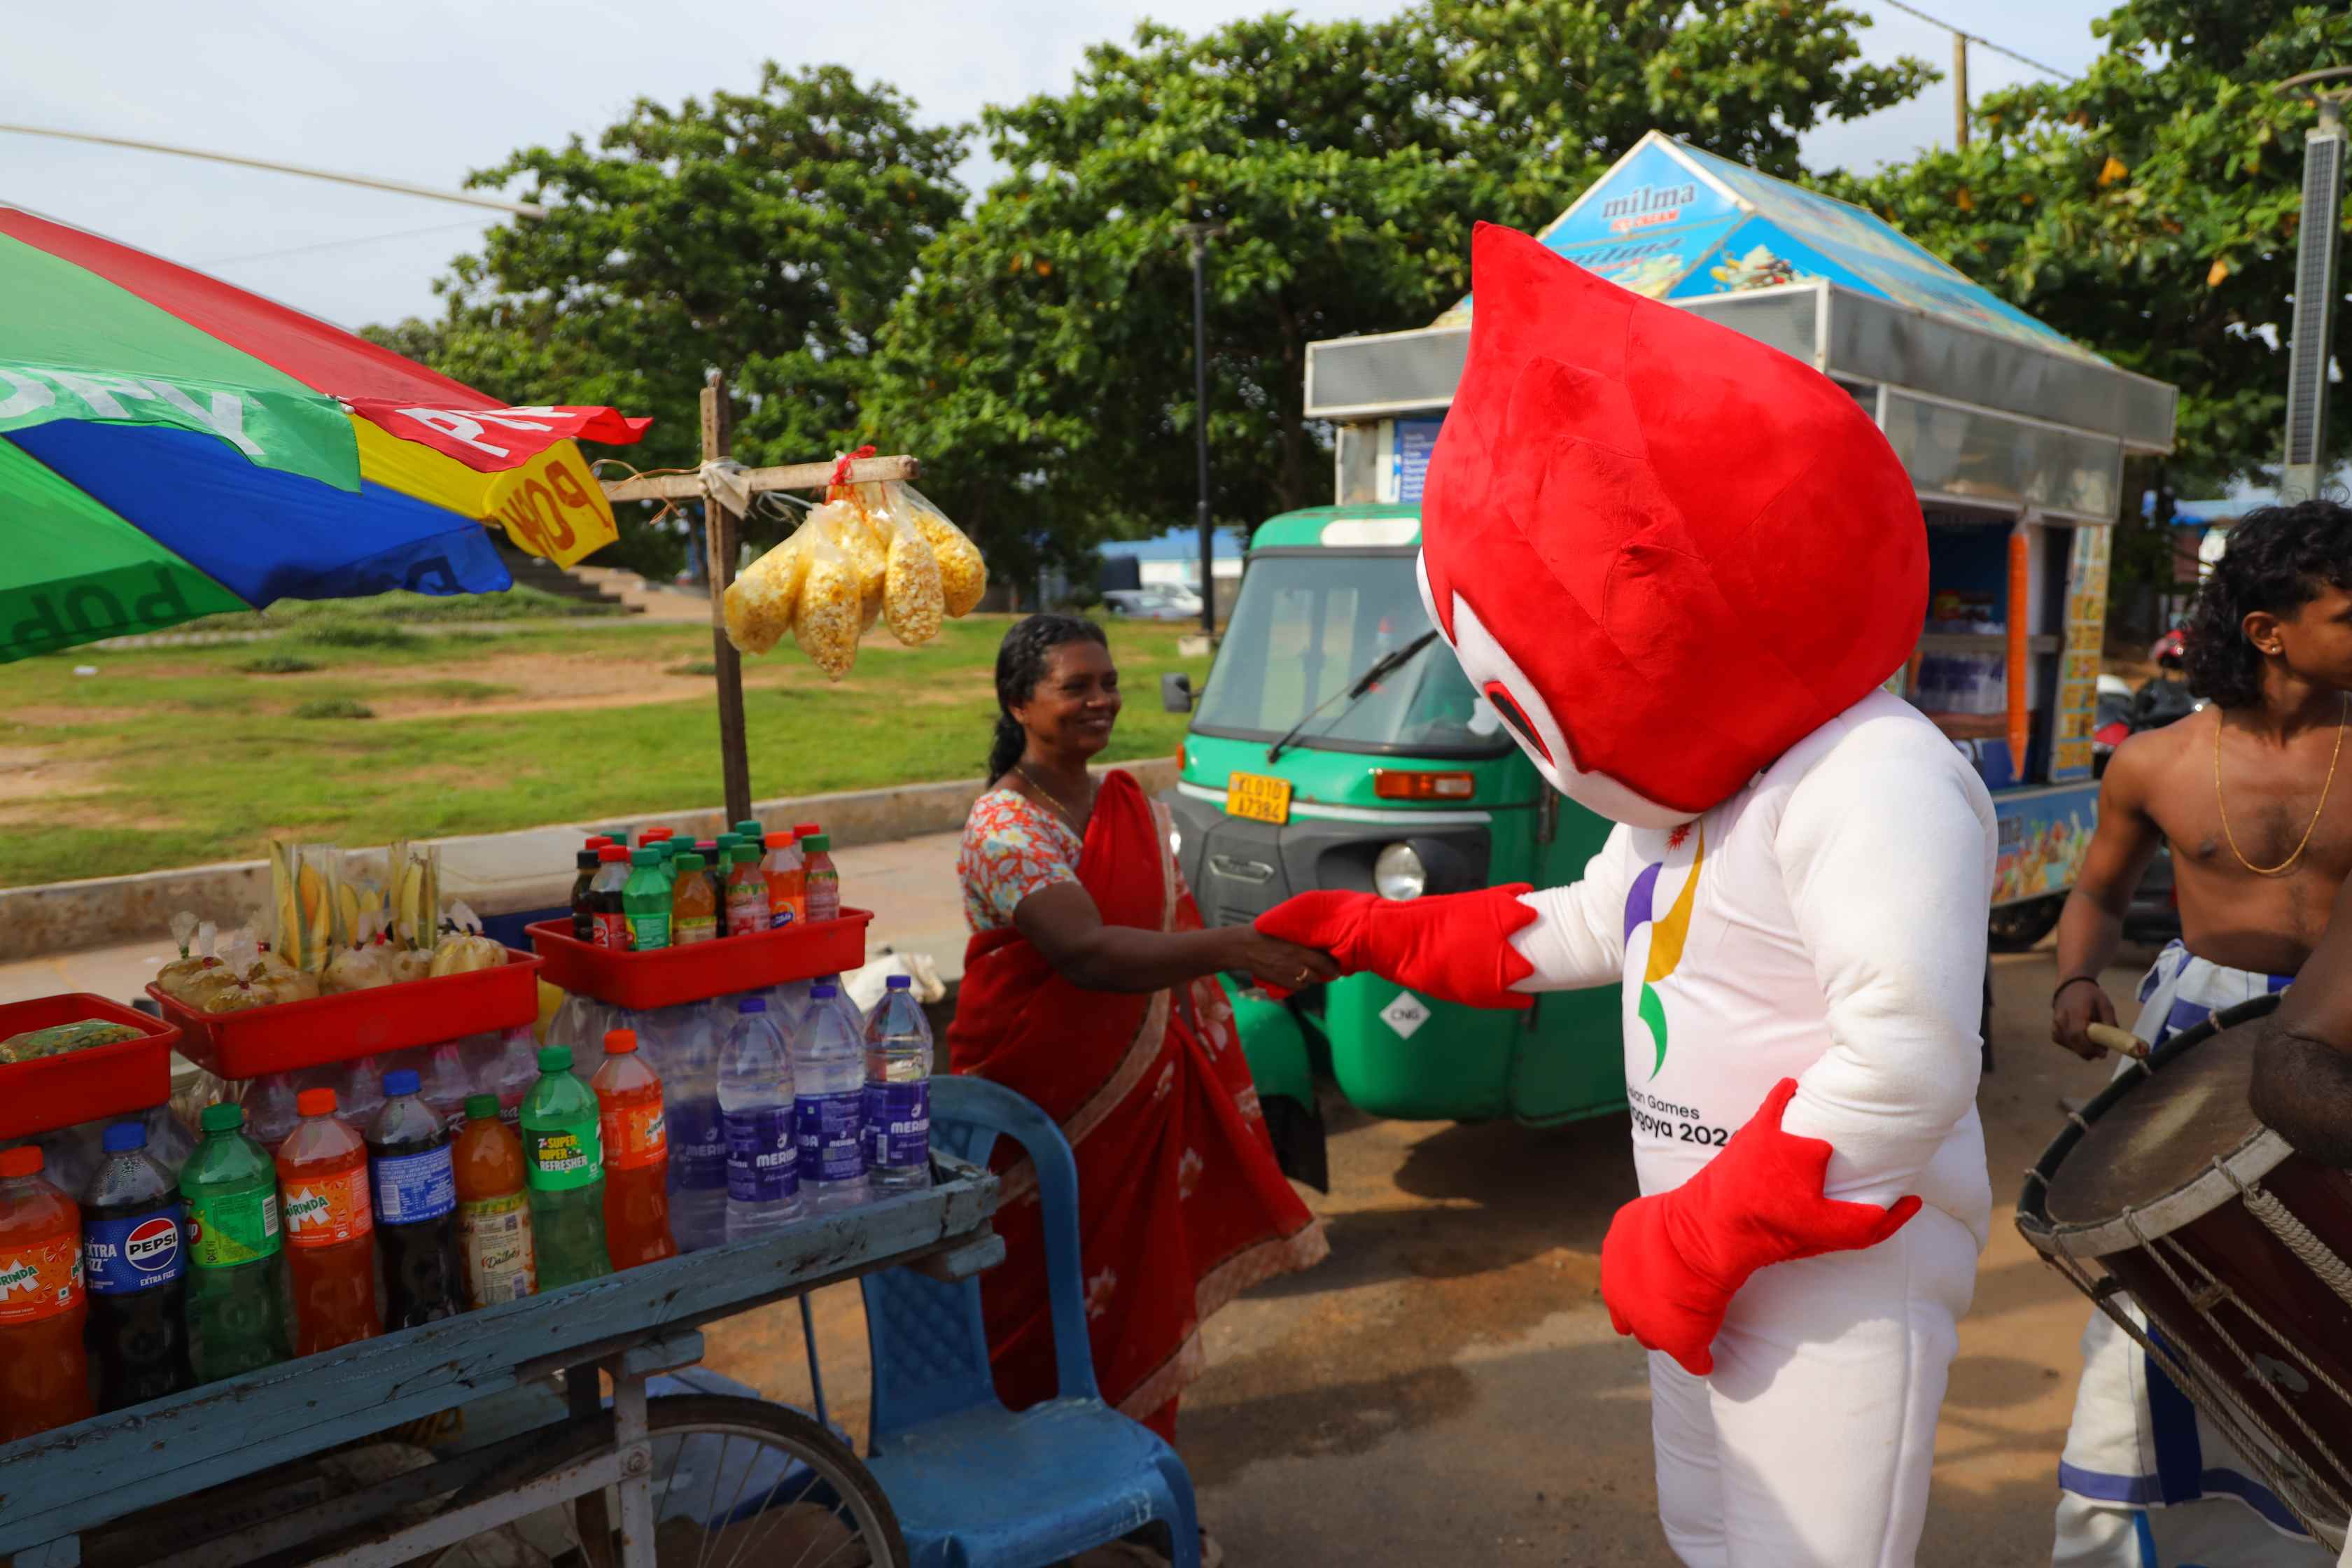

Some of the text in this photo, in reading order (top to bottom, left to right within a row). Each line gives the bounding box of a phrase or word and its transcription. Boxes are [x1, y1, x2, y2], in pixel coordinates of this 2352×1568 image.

[1602, 183, 1695, 218] milma
[1390, 1007, 1420, 1021] CNG
[1647, 1095, 1700, 1120] Games
[1679, 1123, 1740, 1148] 202
[539, 1154, 588, 1172] REFRESHER
[128, 1232, 177, 1256] PEPSI
[0, 1265, 37, 1287] RINDA
[140, 1274, 162, 1287] EXTRA
